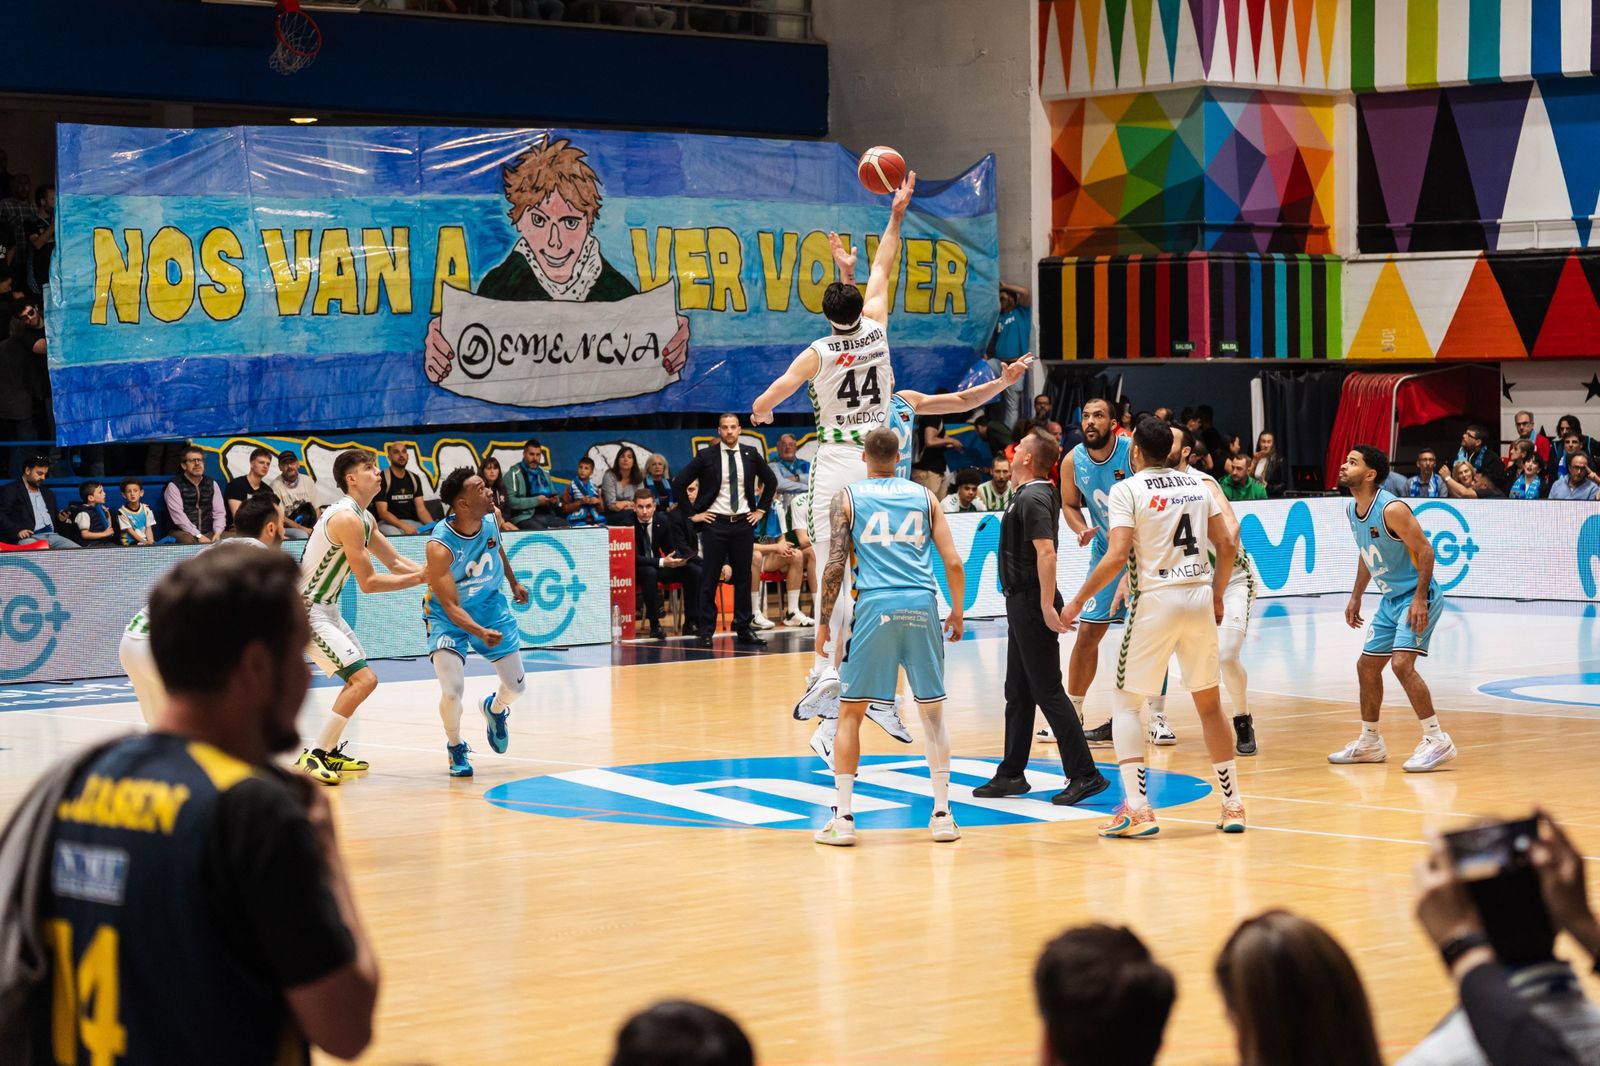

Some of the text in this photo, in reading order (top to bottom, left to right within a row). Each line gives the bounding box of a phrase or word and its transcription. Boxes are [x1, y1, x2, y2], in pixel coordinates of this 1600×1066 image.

[91, 226, 246, 325] NOS
[261, 226, 413, 316] VAN
[430, 226, 472, 316] A
[631, 226, 748, 313] VER
[828, 342, 841, 352] DE
[837, 366, 881, 408] 44
[846, 411, 885, 425] MEDAC
[1144, 476, 1198, 490] POLANCO
[860, 511, 926, 550] 44
[1173, 513, 1199, 557] 4
[1171, 562, 1211, 579] MEDAC
[46, 917, 128, 1066] 14
